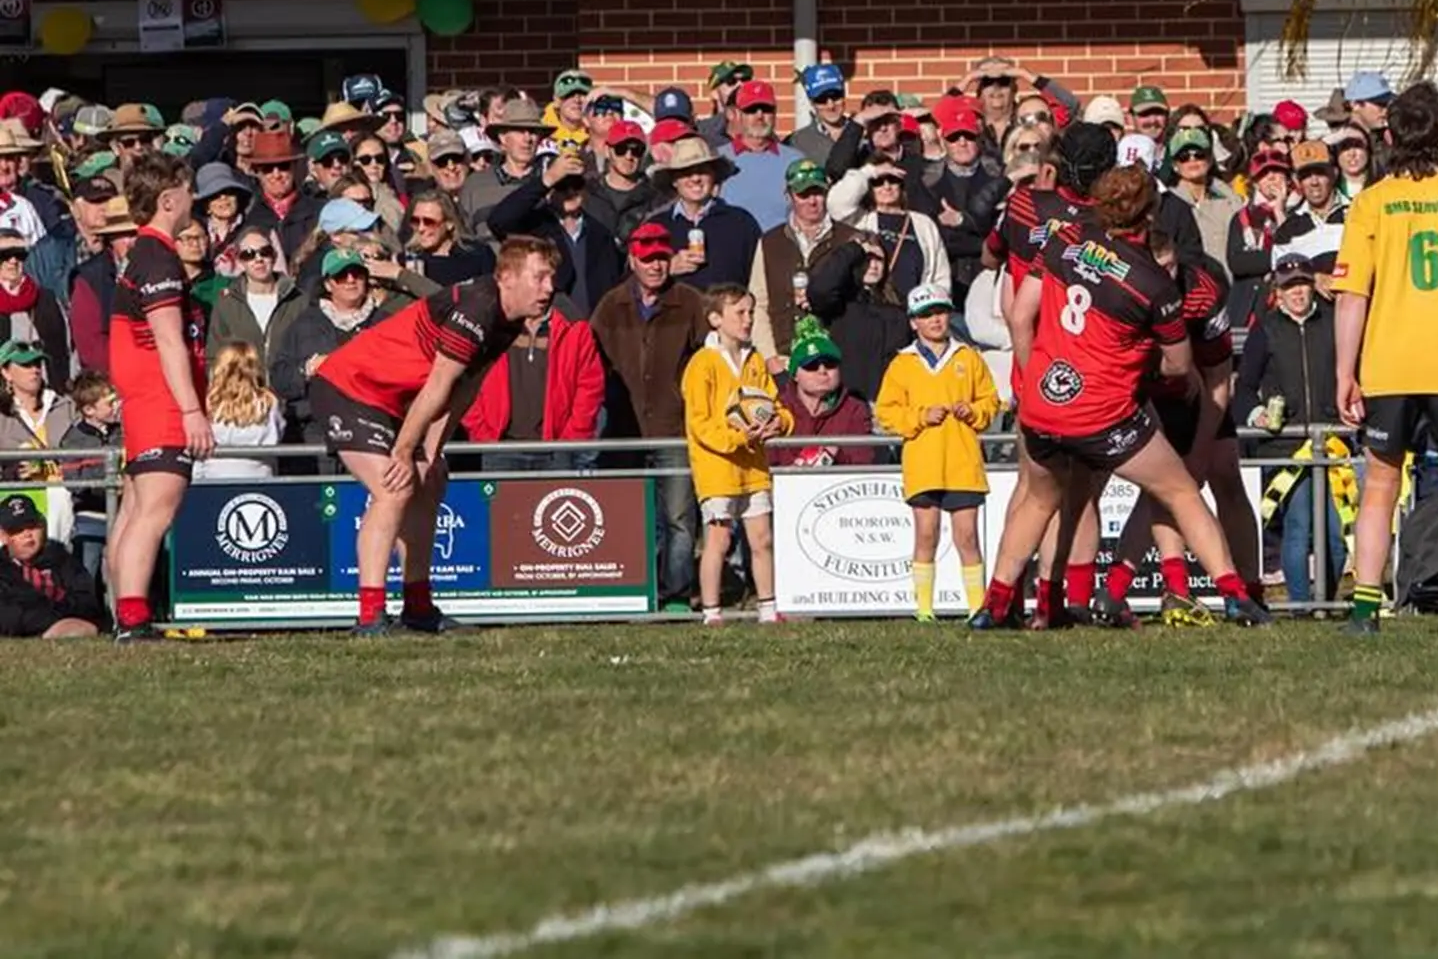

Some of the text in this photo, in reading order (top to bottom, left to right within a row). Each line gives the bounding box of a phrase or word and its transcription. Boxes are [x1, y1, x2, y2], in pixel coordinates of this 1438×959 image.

[1060, 284, 1092, 335] 8
[814, 482, 904, 513] STONEHA
[235, 510, 270, 541] M
[839, 517, 912, 529] BOOROWA
[824, 554, 914, 578] FURNITUR
[818, 590, 889, 605] BUILDING
